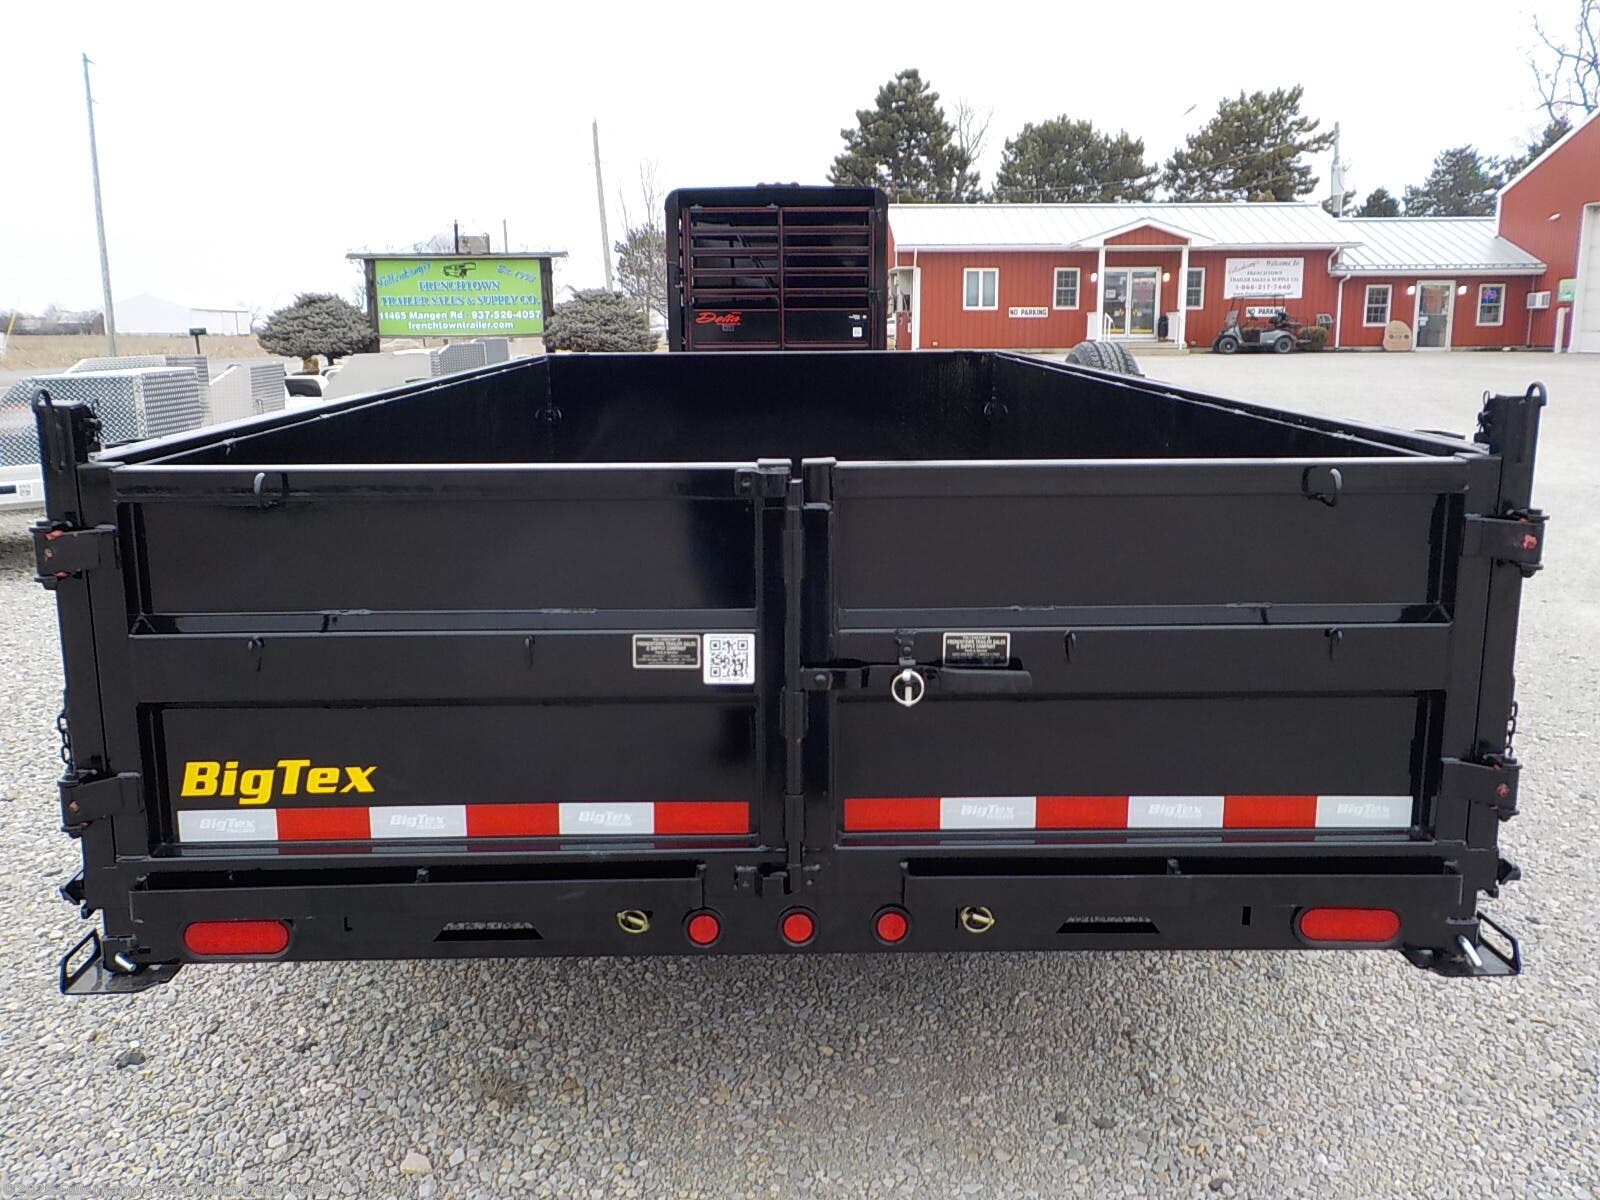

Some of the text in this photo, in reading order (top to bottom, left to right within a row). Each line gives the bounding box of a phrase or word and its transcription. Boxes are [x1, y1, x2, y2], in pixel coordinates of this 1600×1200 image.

[418, 280, 499, 292] FRENCHTOWN
[381, 295, 430, 306] TRAILER
[431, 295, 465, 306] SALES
[466, 295, 475, 306] &
[477, 294, 518, 306] SUPPLY
[380, 311, 407, 320] 11465
[409, 311, 447, 321] Mangen
[450, 310, 464, 319] Rd
[696, 312, 741, 324] Delta
[408, 320, 514, 331] frenchtowntrailer.com
[180, 759, 377, 805] BigTex
[961, 803, 1015, 817] BigTex
[390, 814, 446, 828] BigTex
[579, 811, 633, 824] BigTex
[200, 818, 256, 831] BigTex
